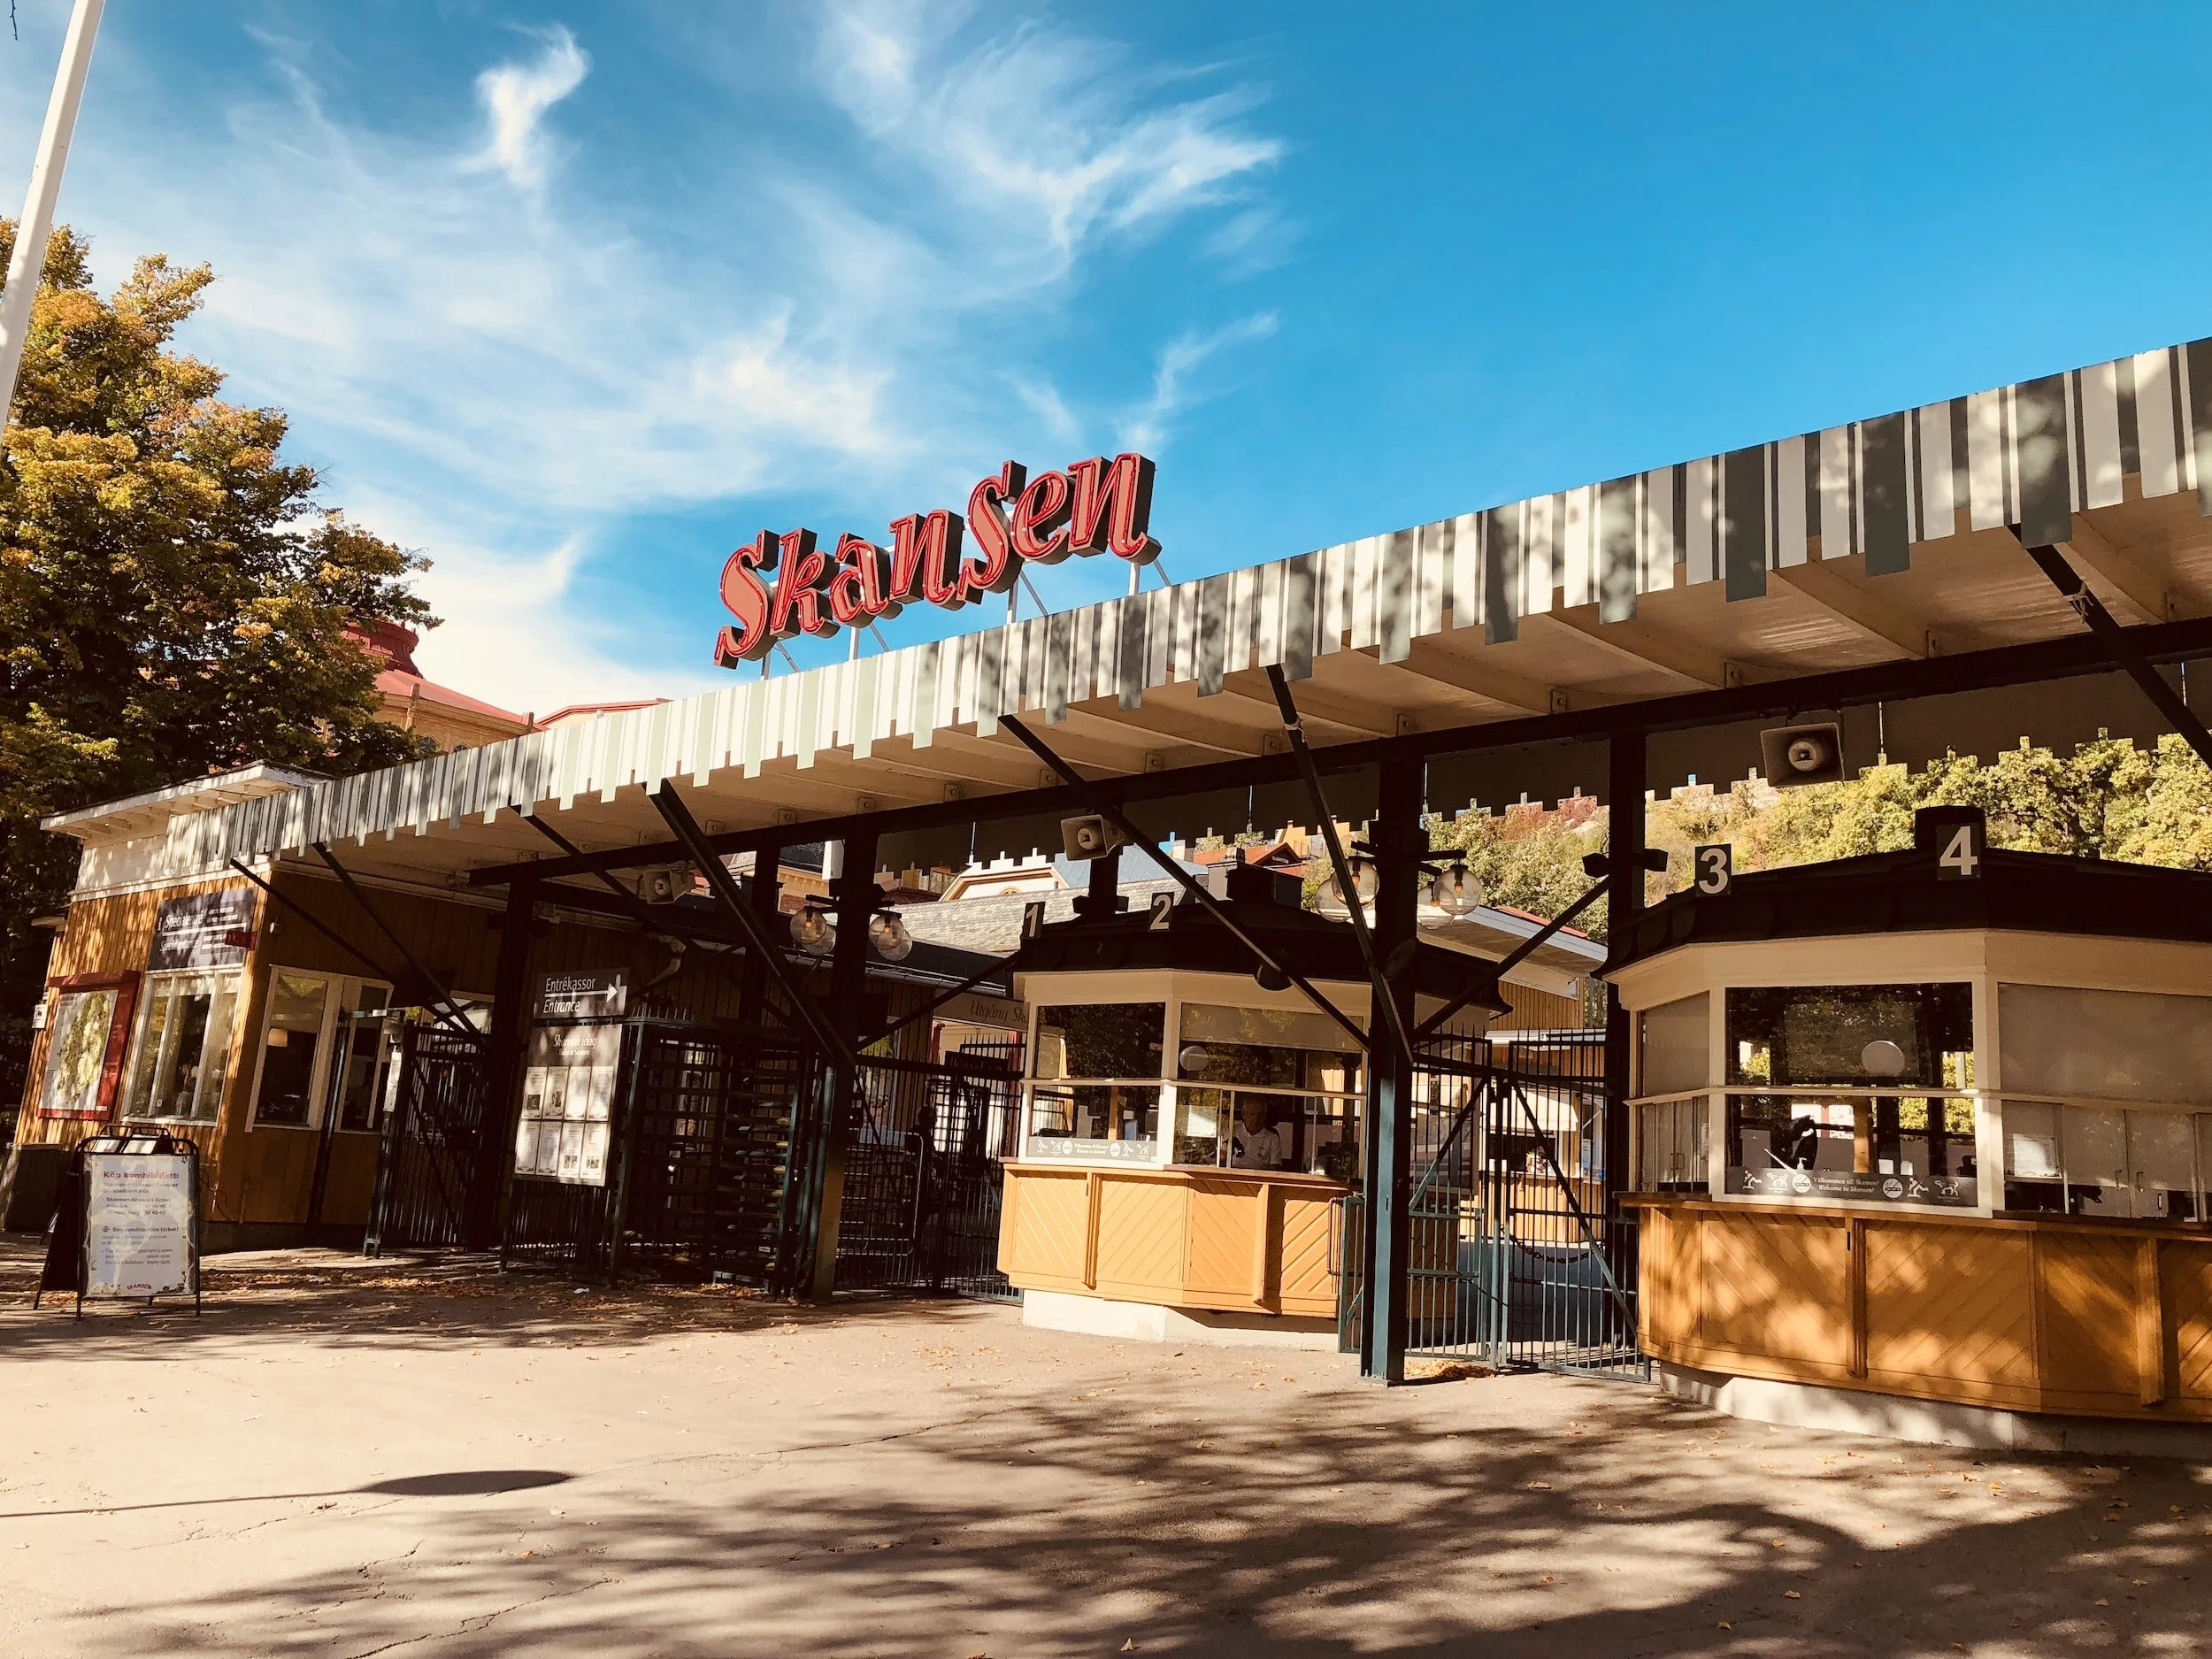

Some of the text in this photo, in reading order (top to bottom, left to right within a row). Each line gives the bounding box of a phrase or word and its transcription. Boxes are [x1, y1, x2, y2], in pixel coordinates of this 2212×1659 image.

[1939, 826, 1978, 876] 4
[1698, 848, 1729, 895] 3
[1025, 903, 1039, 938] 1
[1149, 895, 1171, 931] 2
[545, 976, 596, 992] Entrékassor
[542, 999, 580, 1014] Entrance
[970, 998, 1009, 1023] Utgång
[580, 1033, 597, 1049] idag
[103, 1171, 121, 1180] Köp
